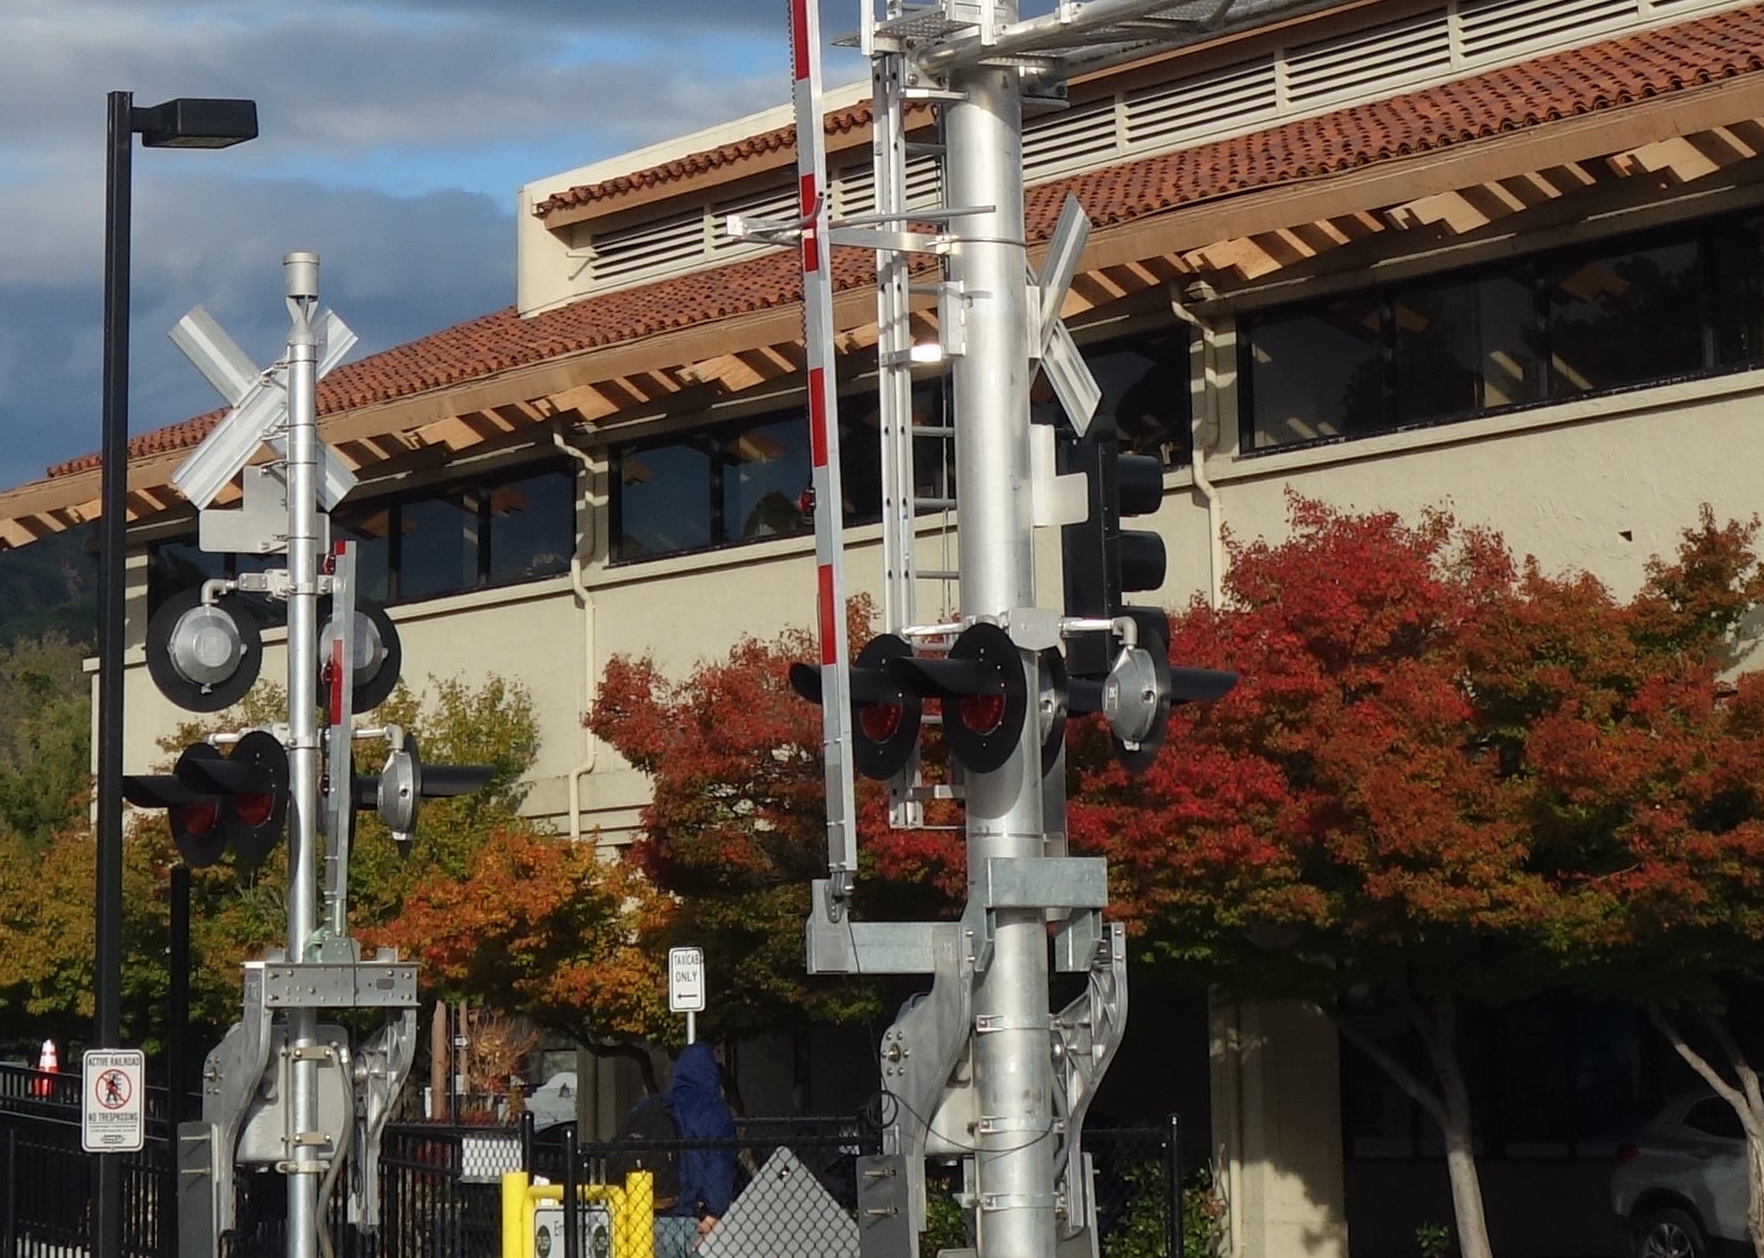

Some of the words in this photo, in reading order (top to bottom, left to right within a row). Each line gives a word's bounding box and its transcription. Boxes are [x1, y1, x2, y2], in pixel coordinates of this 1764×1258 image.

[674, 953, 700, 965] TAXICAB
[676, 971, 698, 982] ONLY
[89, 1057, 108, 1066] ACTIVE
[110, 1056, 140, 1066] RAILROAD
[89, 1113, 97, 1122] NO
[98, 1113, 138, 1122] TRESPASSING
